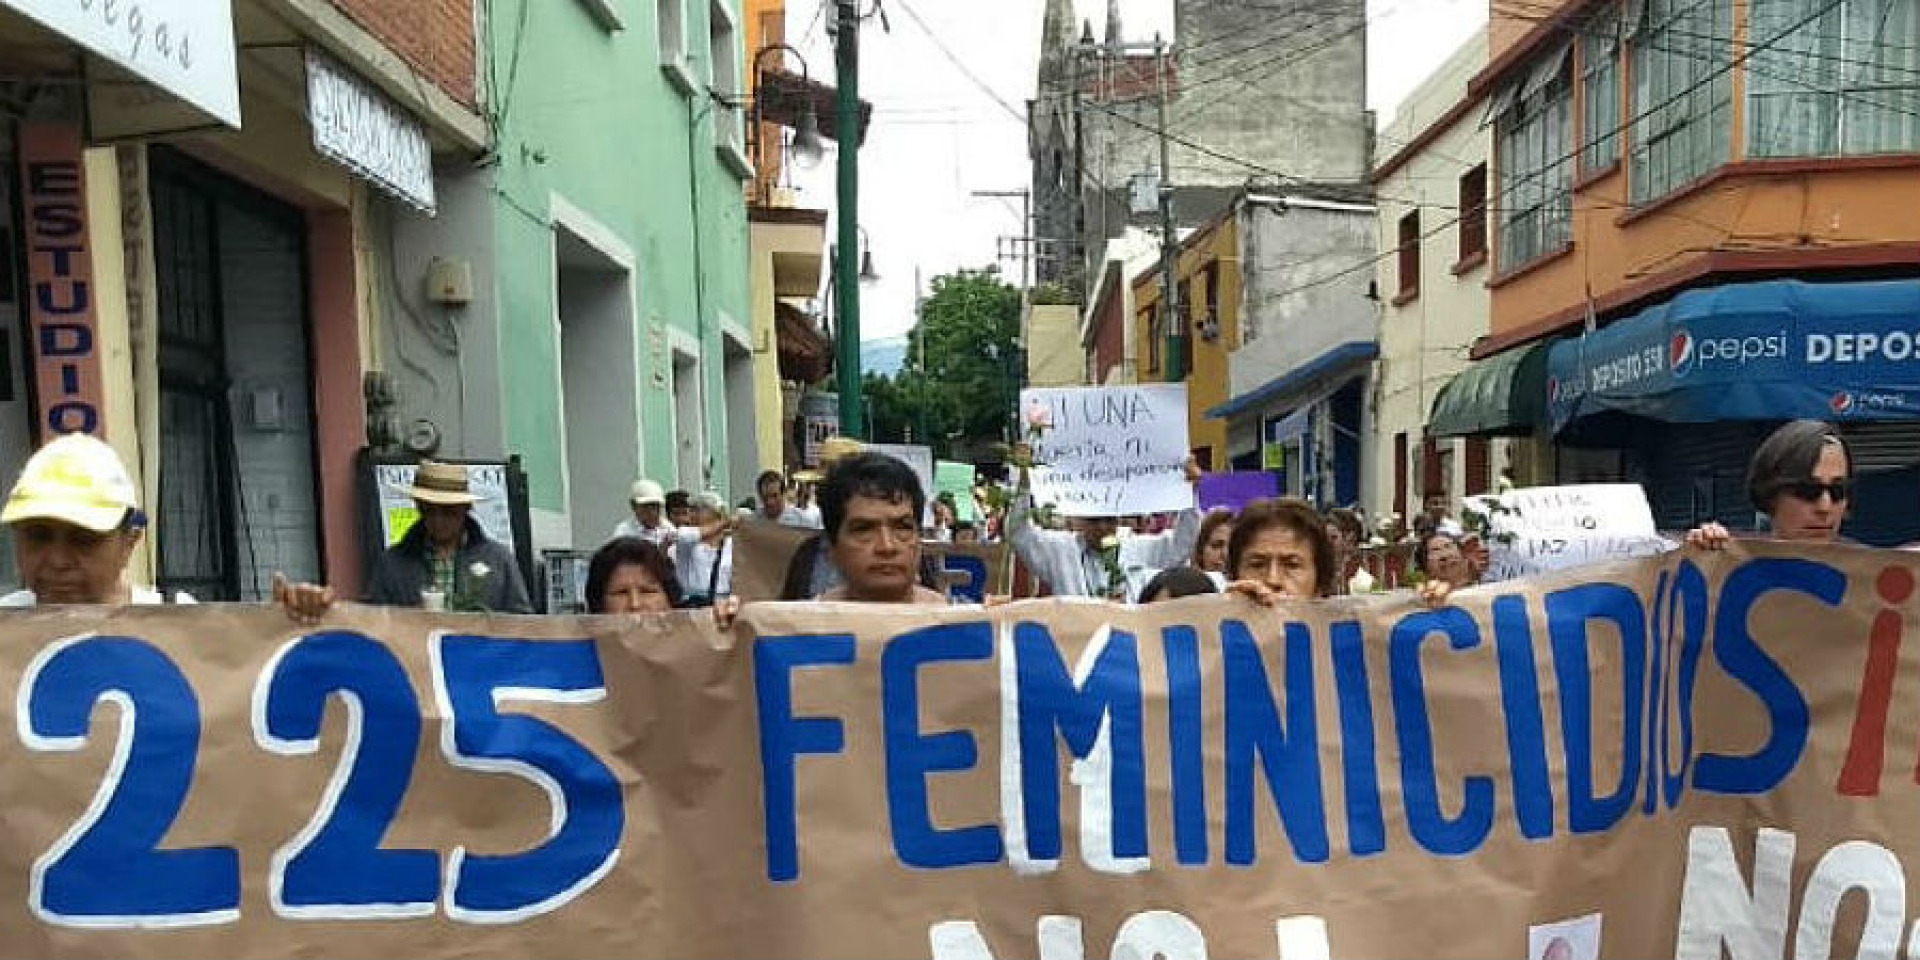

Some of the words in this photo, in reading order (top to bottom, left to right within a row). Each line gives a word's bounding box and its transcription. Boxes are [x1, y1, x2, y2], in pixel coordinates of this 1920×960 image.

[27, 161, 97, 434] ESTUDIO
[1700, 330, 1786, 369] pepsi
[1083, 391, 1156, 427] UNA
[17, 629, 626, 929] 225
[753, 556, 1849, 883] FEMINICIDIOS
